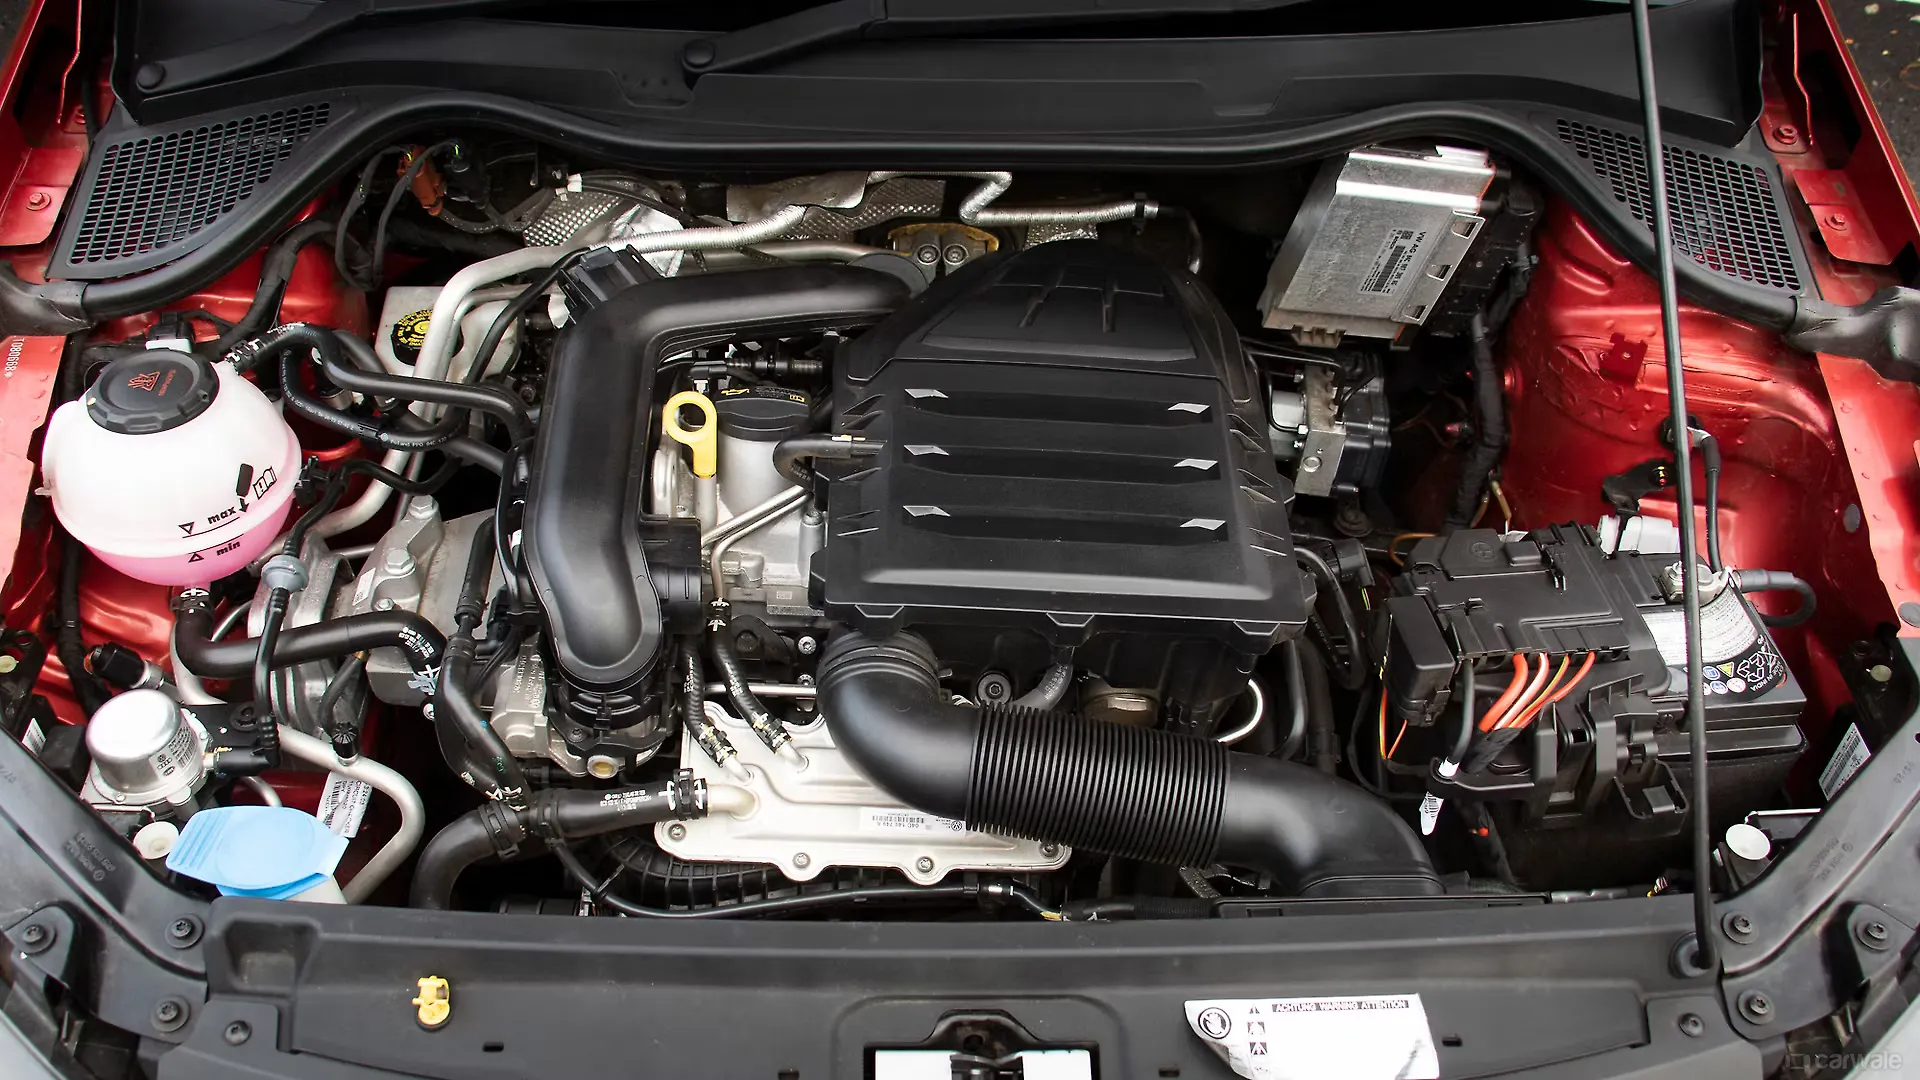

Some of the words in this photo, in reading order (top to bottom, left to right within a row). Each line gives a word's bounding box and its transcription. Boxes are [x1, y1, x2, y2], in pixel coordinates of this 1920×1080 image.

[207, 506, 237, 525] max
[216, 541, 241, 556] min
[1766, 673, 1774, 682] IN
[1750, 678, 1768, 691] INDIA
[1276, 1003, 1316, 1012] ACHTUNG
[1320, 1002, 1359, 1011] WARNING
[1361, 1000, 1406, 1010] ATTENTION
